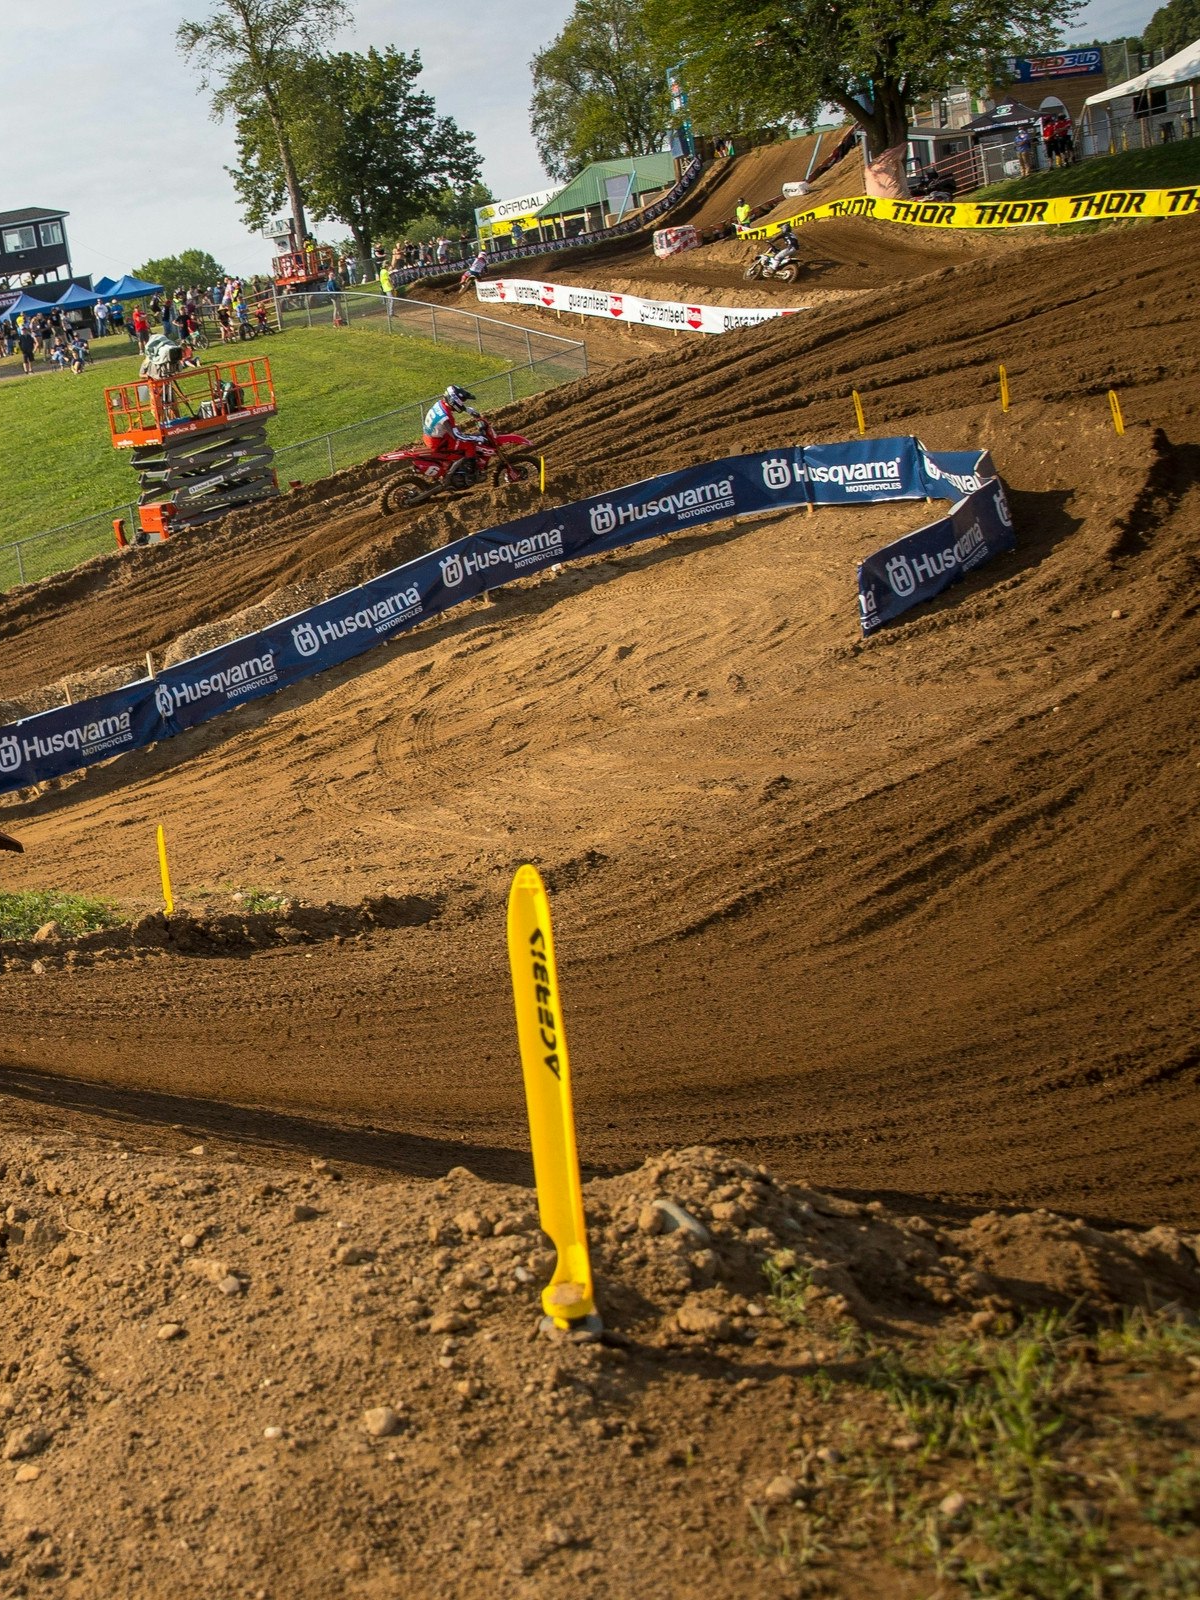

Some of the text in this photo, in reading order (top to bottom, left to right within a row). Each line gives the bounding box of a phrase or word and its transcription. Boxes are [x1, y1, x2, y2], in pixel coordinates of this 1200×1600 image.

[498, 196, 544, 216] OFFICIAL
[828, 198, 876, 217] THOR
[892, 202, 956, 225] THOR
[975, 201, 1049, 225] THOR
[1069, 192, 1146, 219] THOR
[568, 294, 609, 311] guaranteed
[792, 459, 900, 485] Husqvarna
[845, 482, 902, 493] MOTORCYCLES
[617, 479, 733, 525] Husqvarna
[677, 499, 735, 521] MOTORCYCLES
[463, 528, 562, 576] Husqvarna
[514, 547, 564, 570] MOTORCYCLES
[317, 587, 422, 644] Husqvarna
[375, 606, 423, 634] MOTORCYCLES
[172, 653, 275, 707] Husqvarna
[226, 674, 278, 699] MOTORCYCLES
[23, 711, 130, 762] Husqvarna
[81, 732, 133, 757] MOTORCYCLES
